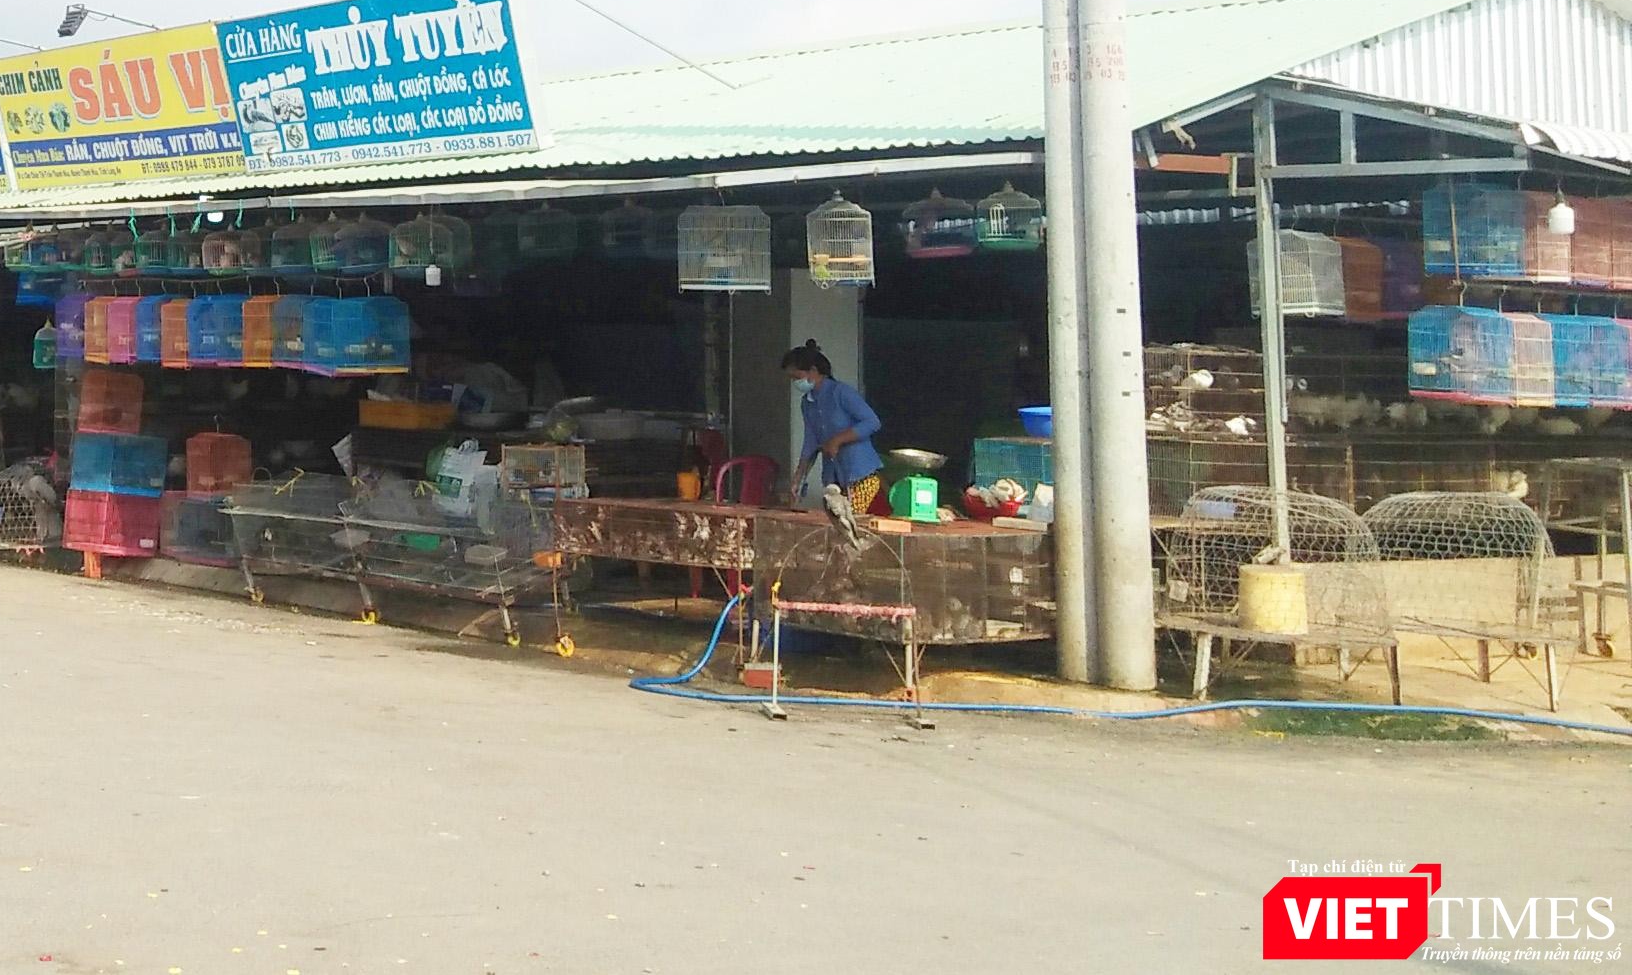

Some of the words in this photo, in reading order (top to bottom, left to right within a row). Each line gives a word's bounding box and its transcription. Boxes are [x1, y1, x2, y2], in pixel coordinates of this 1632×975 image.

[225, 25, 258, 58] CỬA
[258, 20, 302, 54] HÀNG
[28, 61, 63, 92] CẢNH
[68, 49, 162, 123] SÁU
[168, 47, 230, 119] VỊ
[472, 65, 488, 90] CÁ
[488, 63, 512, 88] LÓC
[313, 122, 338, 141] CHIM
[372, 111, 393, 135] CÁC
[420, 105, 442, 129] CÁC
[168, 133, 188, 156] VỊT
[352, 142, 432, 160] 0942.541.773
[443, 134, 531, 152] 0933.881.507
